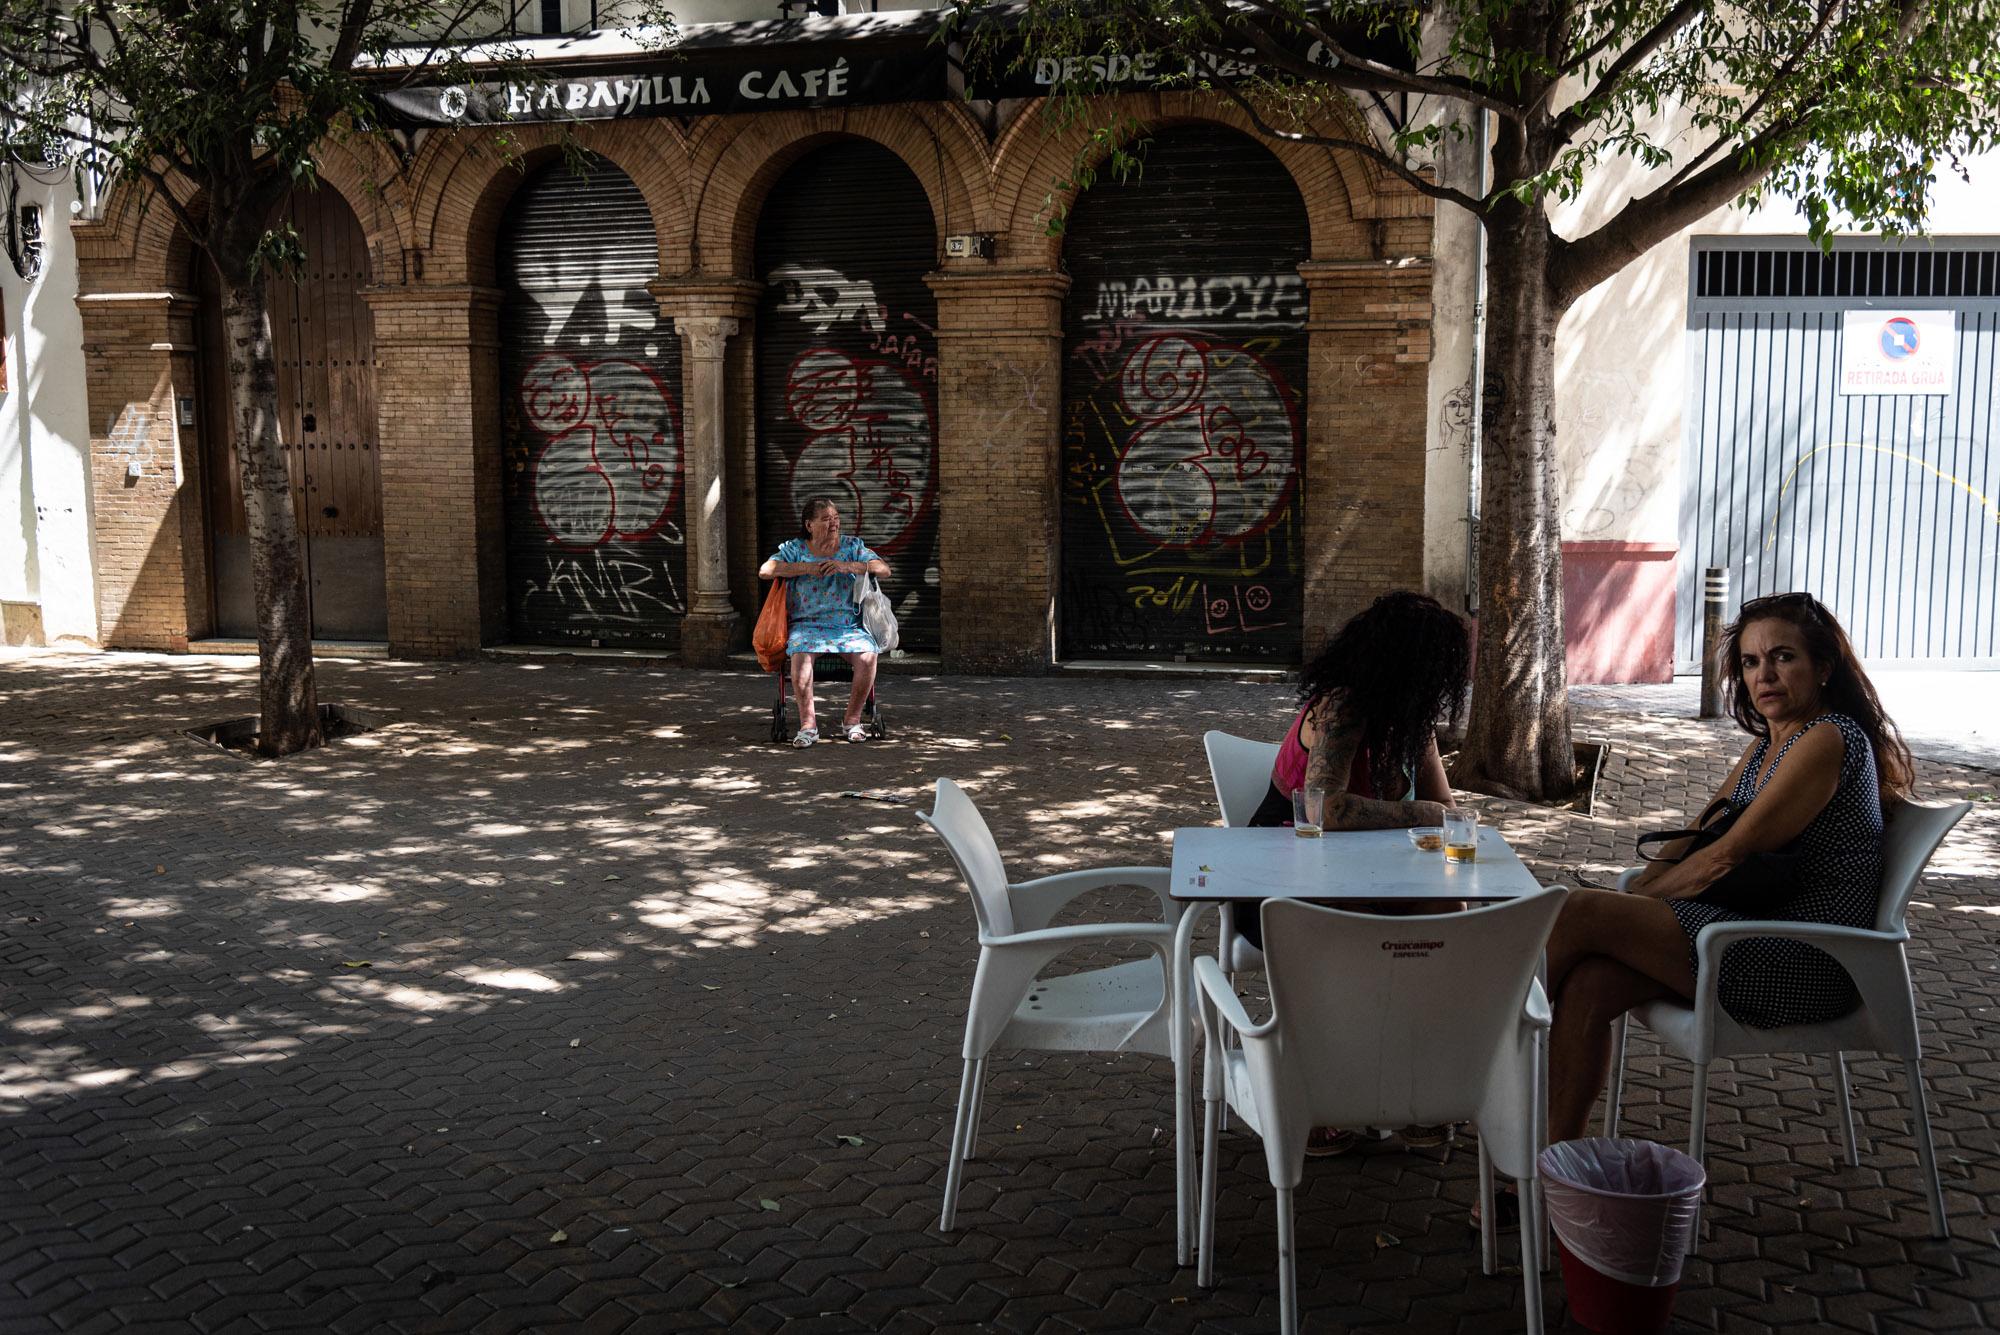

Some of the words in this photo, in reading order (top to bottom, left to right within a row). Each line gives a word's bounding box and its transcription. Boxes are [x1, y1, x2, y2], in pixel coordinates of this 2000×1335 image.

[1034, 53, 1158, 84] DESDE
[508, 76, 712, 116] HABANILLA
[738, 57, 850, 100] CAFÉ
[1847, 371, 1908, 385] RETIRADA
[1911, 371, 1945, 385] GRUA
[1381, 940, 1445, 951] Cruzcampo
